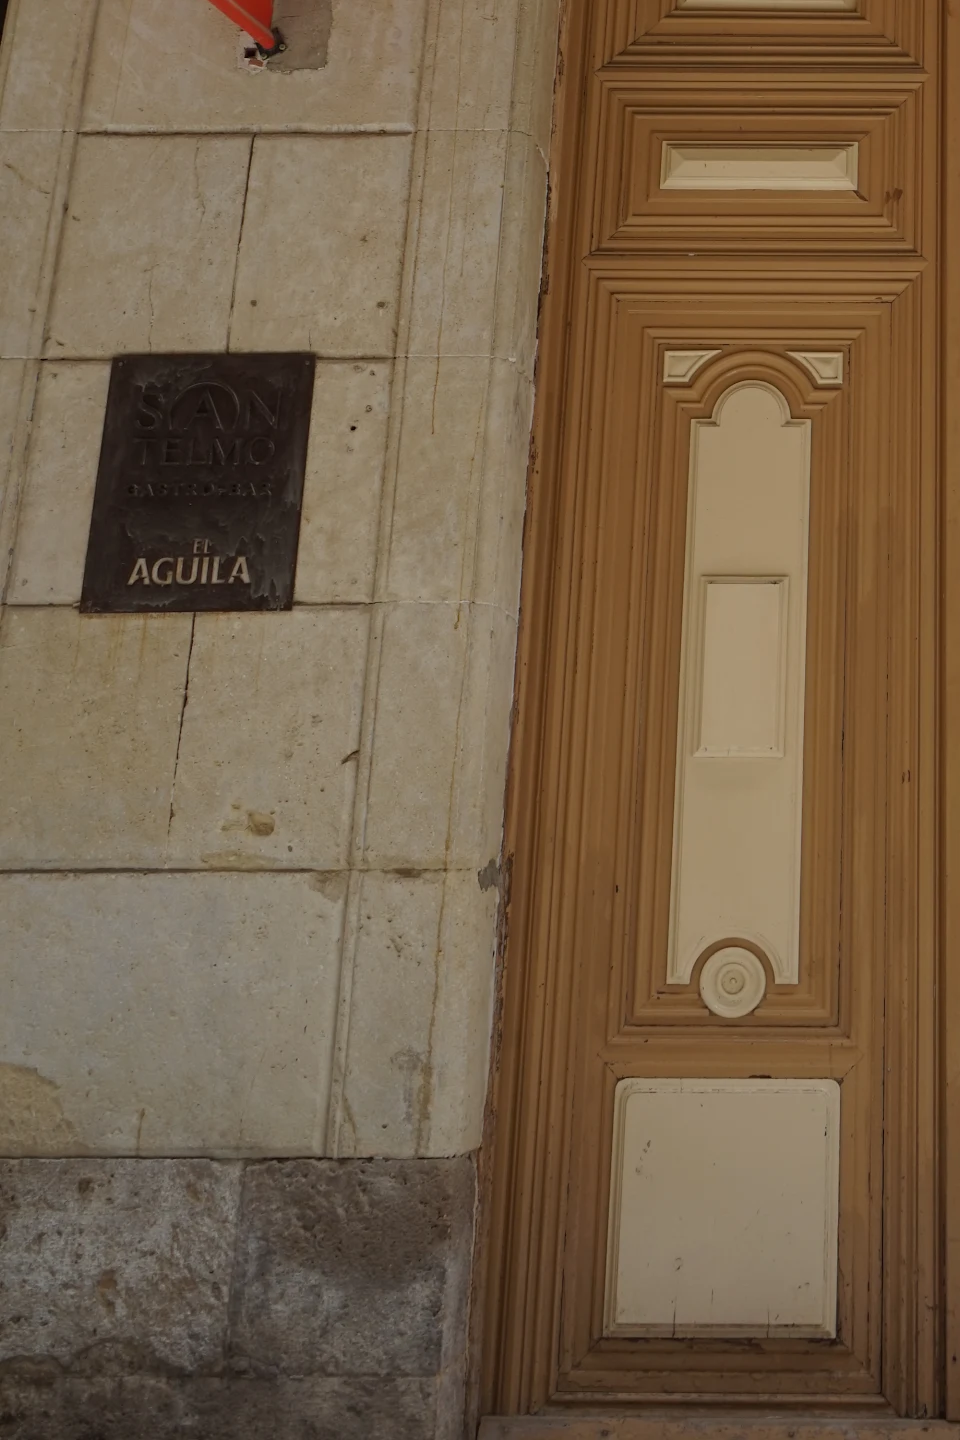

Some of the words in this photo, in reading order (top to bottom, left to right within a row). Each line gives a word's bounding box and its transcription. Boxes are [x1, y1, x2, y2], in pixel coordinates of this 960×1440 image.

[134, 384, 284, 432] SAN
[132, 436, 276, 466] TELMO
[127, 482, 273, 497] GASTRO-BAR
[193, 538, 213, 554] EL
[127, 556, 252, 586] AGUILA
